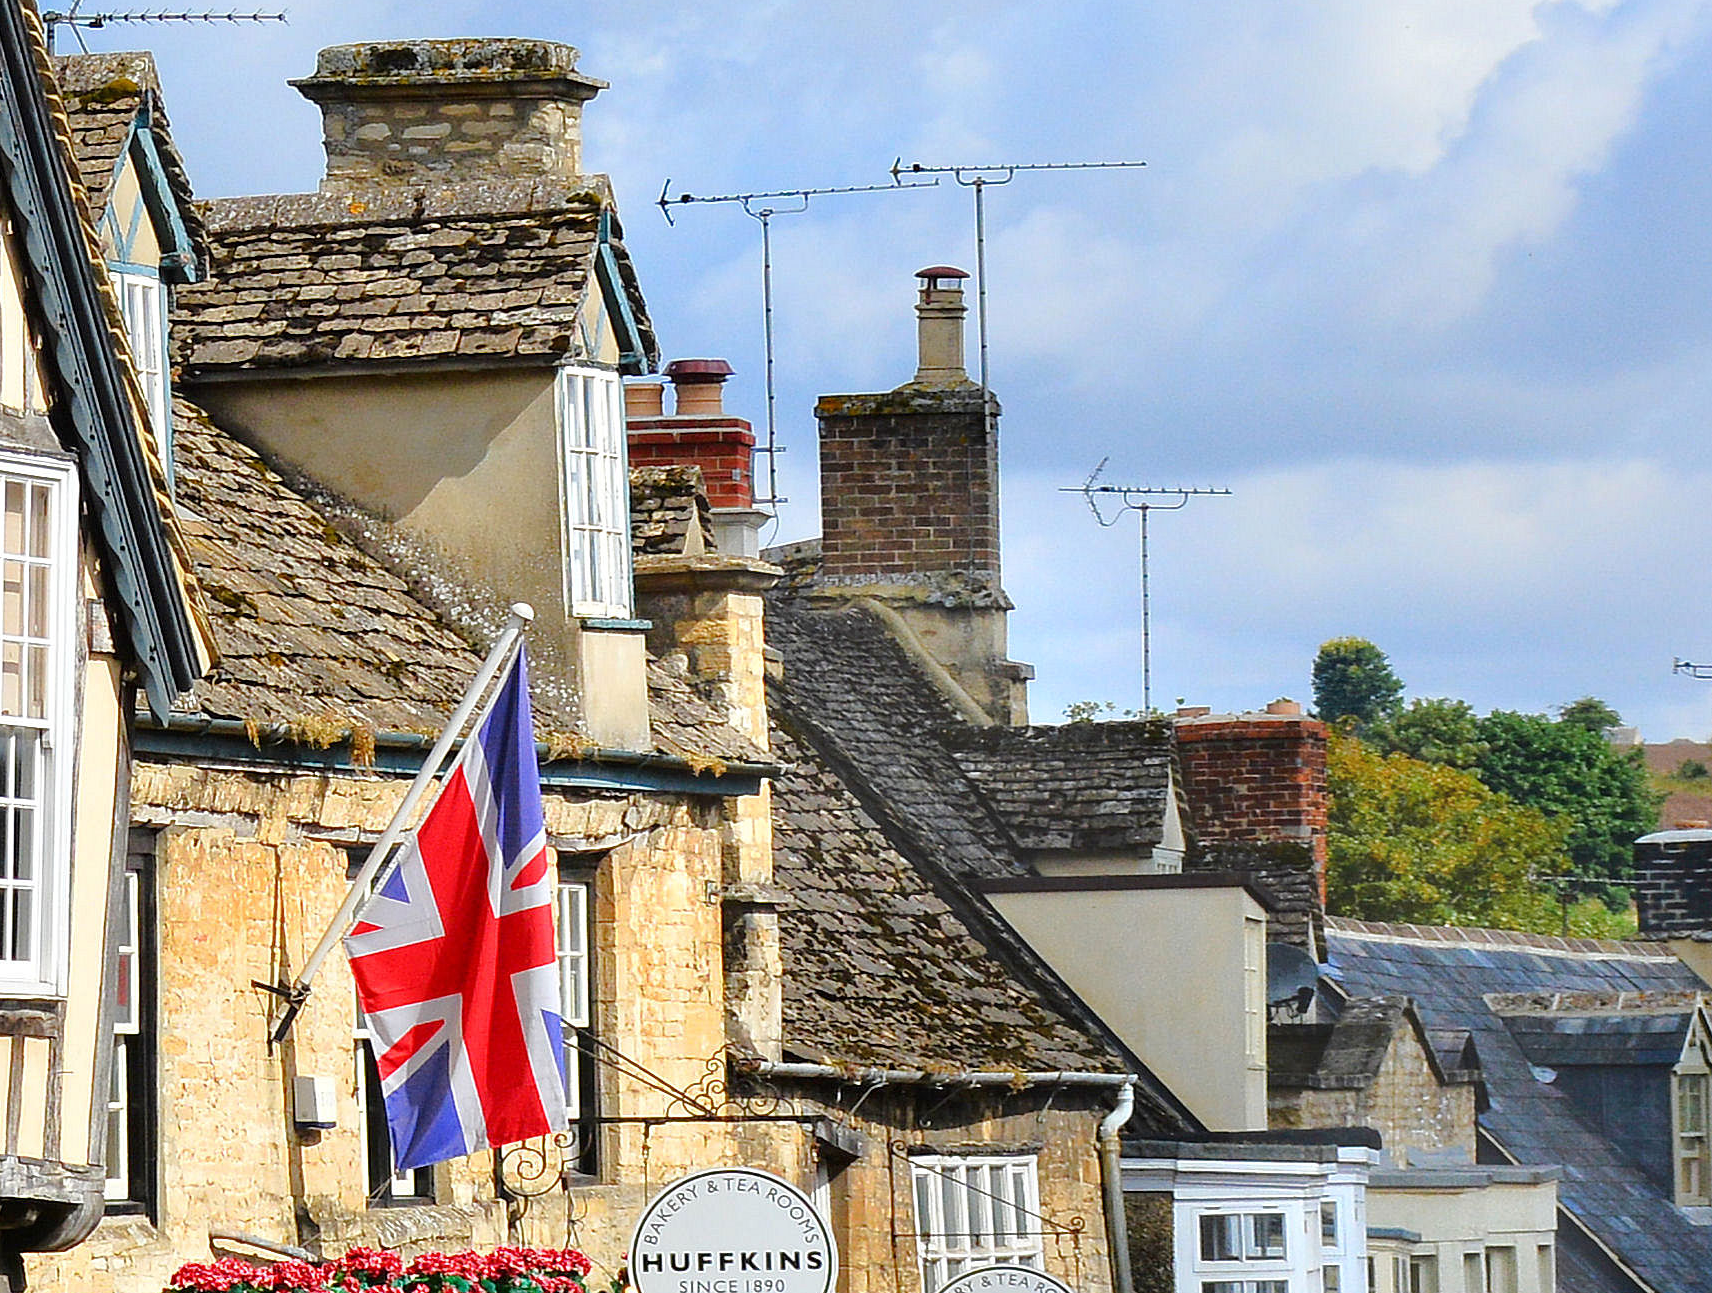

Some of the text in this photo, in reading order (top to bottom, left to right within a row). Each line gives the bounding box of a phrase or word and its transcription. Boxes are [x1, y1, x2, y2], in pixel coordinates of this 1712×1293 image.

[644, 1178, 819, 1245] BAKERY & TEA ROOMS
[642, 1251, 822, 1273] HUFFKINS
[679, 1279, 785, 1293] SINCE 1890
[981, 1276, 992, 1288] &
[997, 1274, 1029, 1288] TEA
